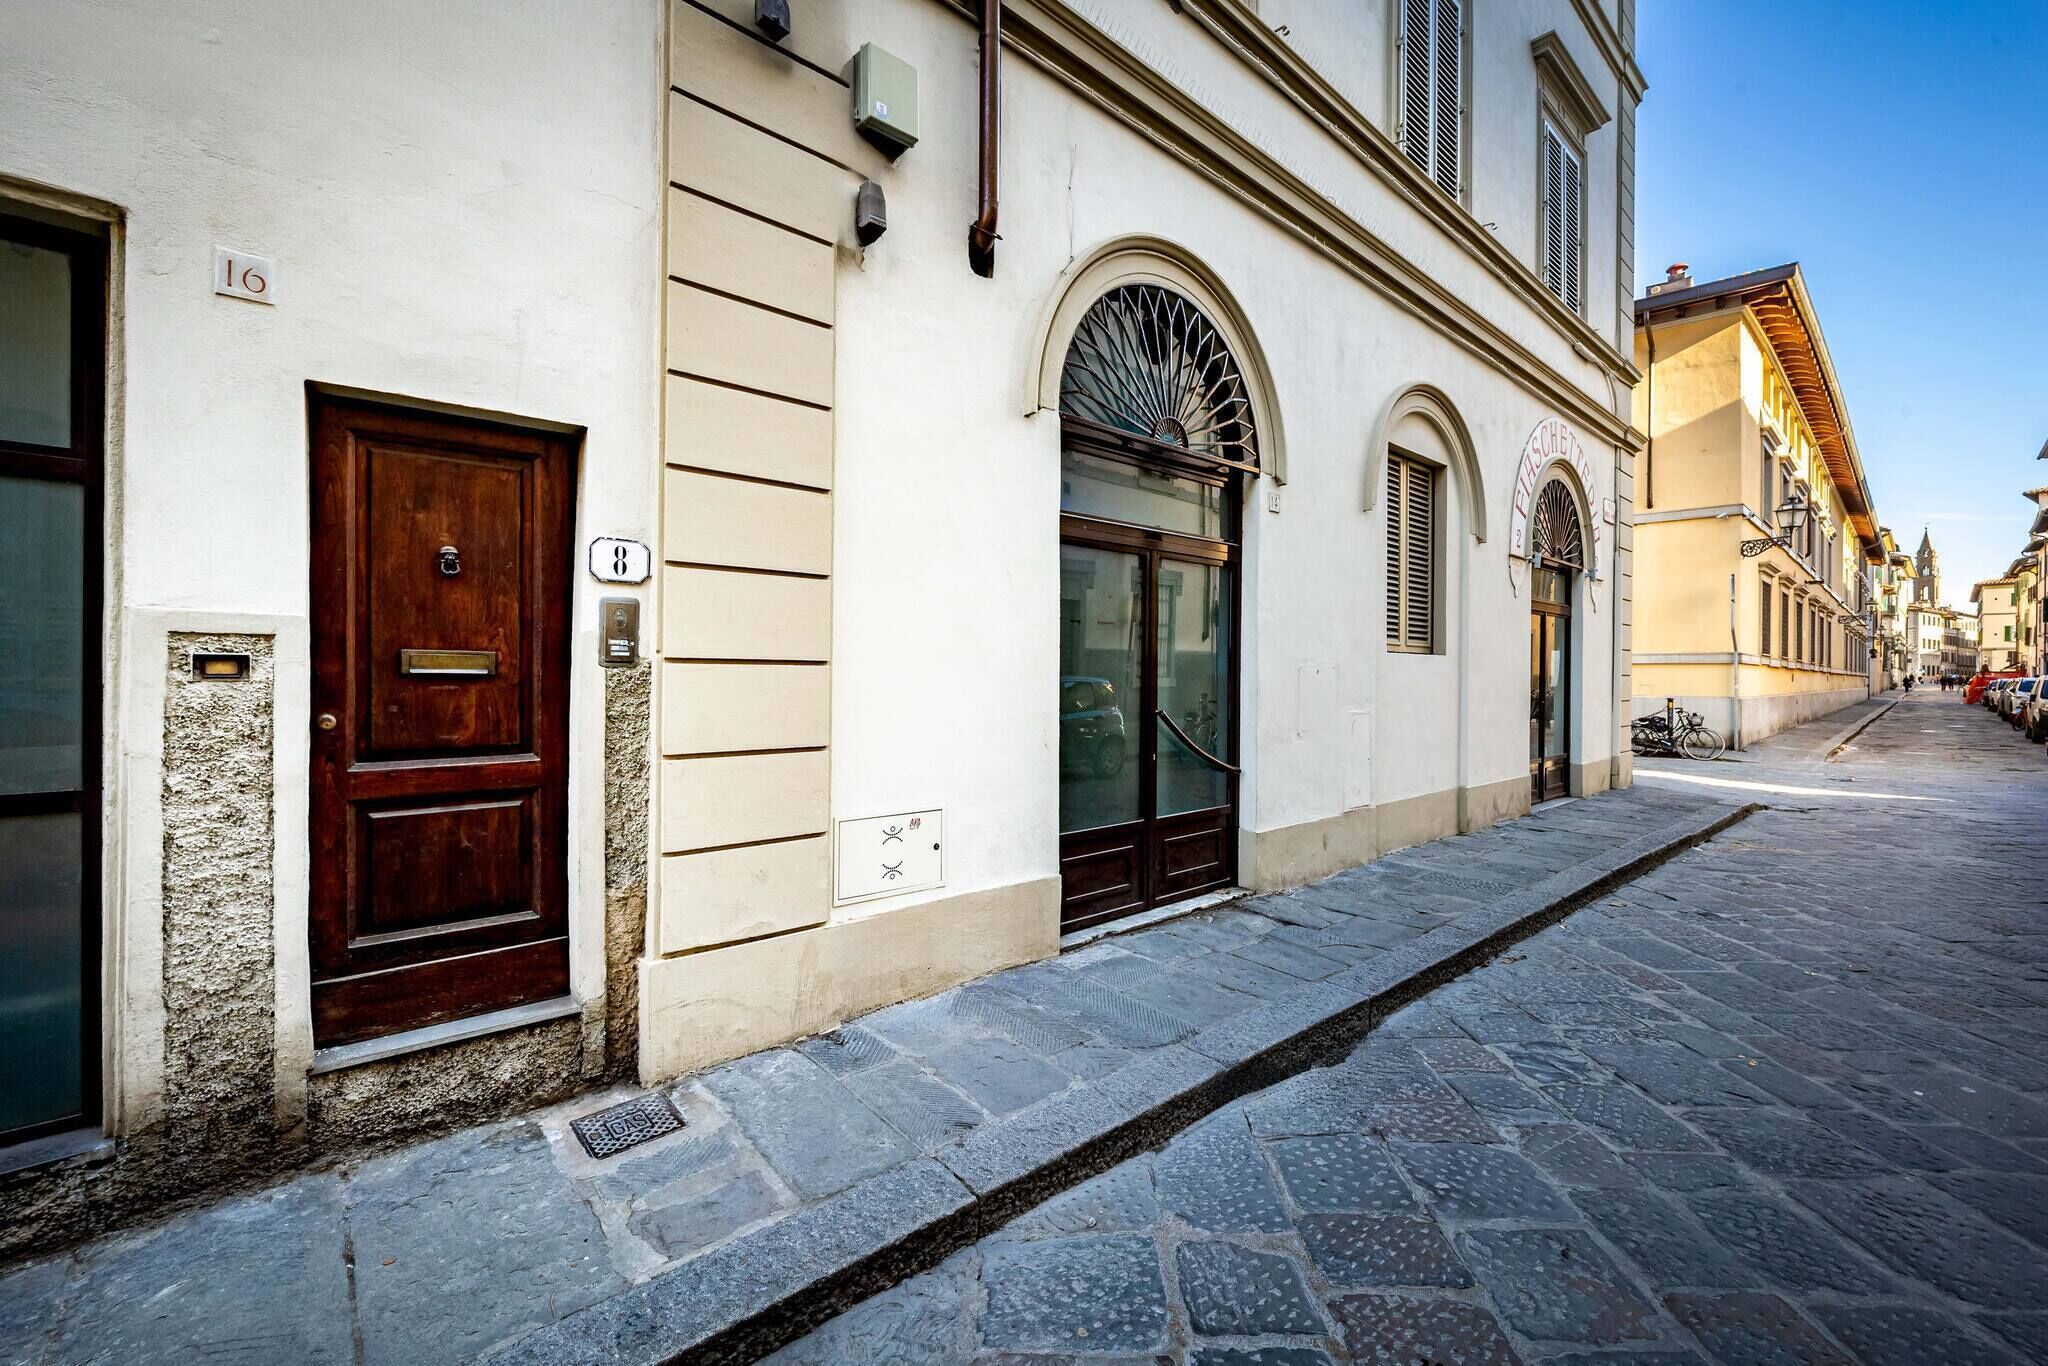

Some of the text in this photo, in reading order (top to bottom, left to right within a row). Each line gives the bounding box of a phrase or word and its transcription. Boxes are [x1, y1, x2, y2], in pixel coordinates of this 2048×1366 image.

[227, 259, 266, 293] 16
[1516, 529, 1522, 548] 2
[613, 545, 627, 576] 8
[610, 1113, 647, 1136] GAS
